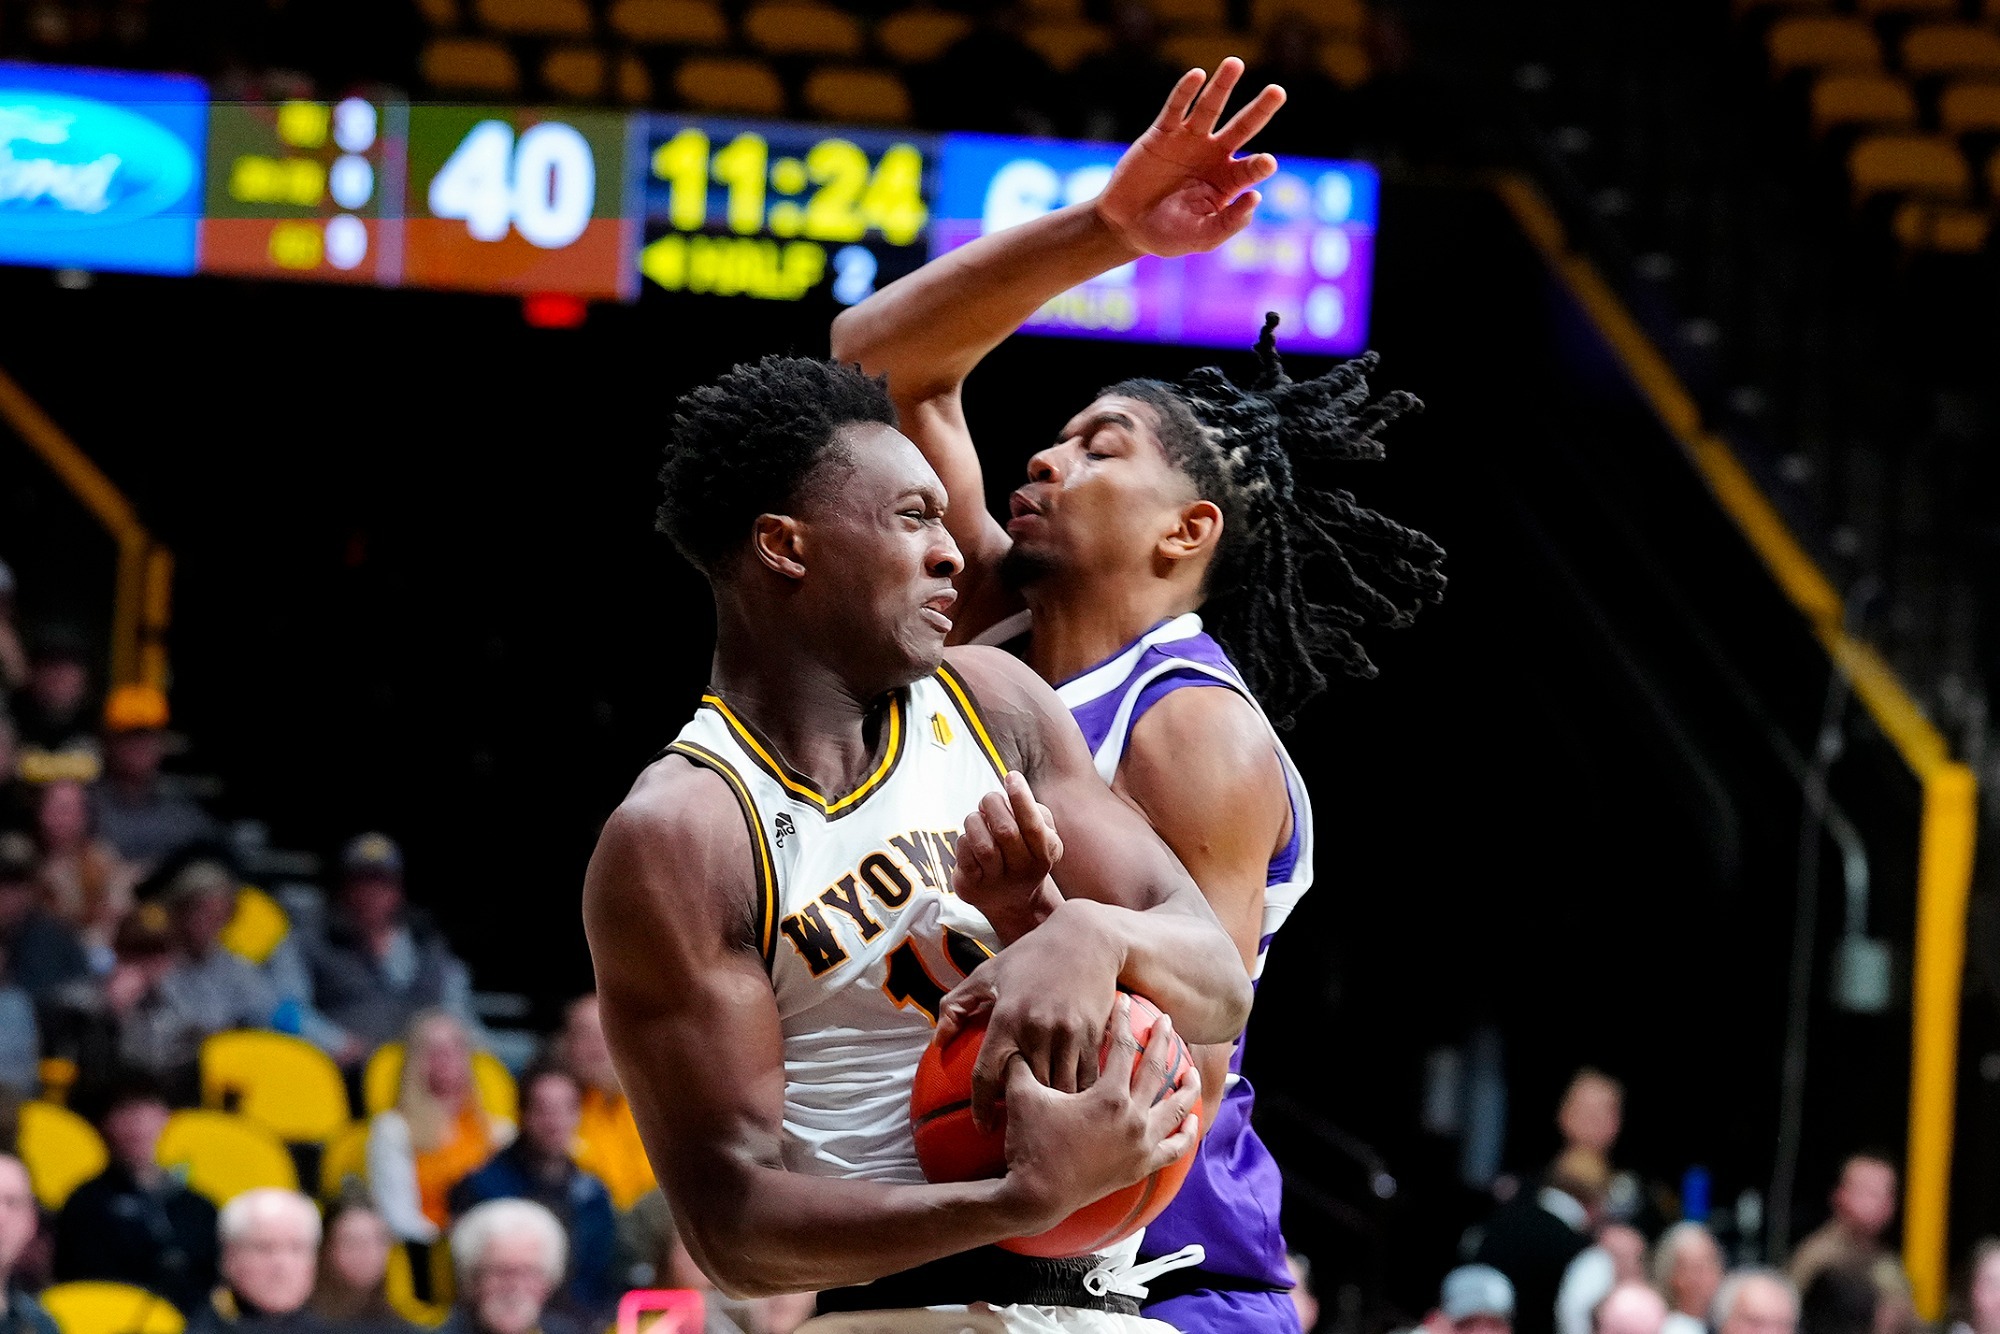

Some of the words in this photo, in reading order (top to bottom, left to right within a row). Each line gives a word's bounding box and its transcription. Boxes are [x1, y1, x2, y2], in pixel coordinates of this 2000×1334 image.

[428, 119, 596, 249] 40
[652, 128, 928, 246] 11:24
[687, 235, 827, 301] HALF
[832, 245, 878, 305] 2
